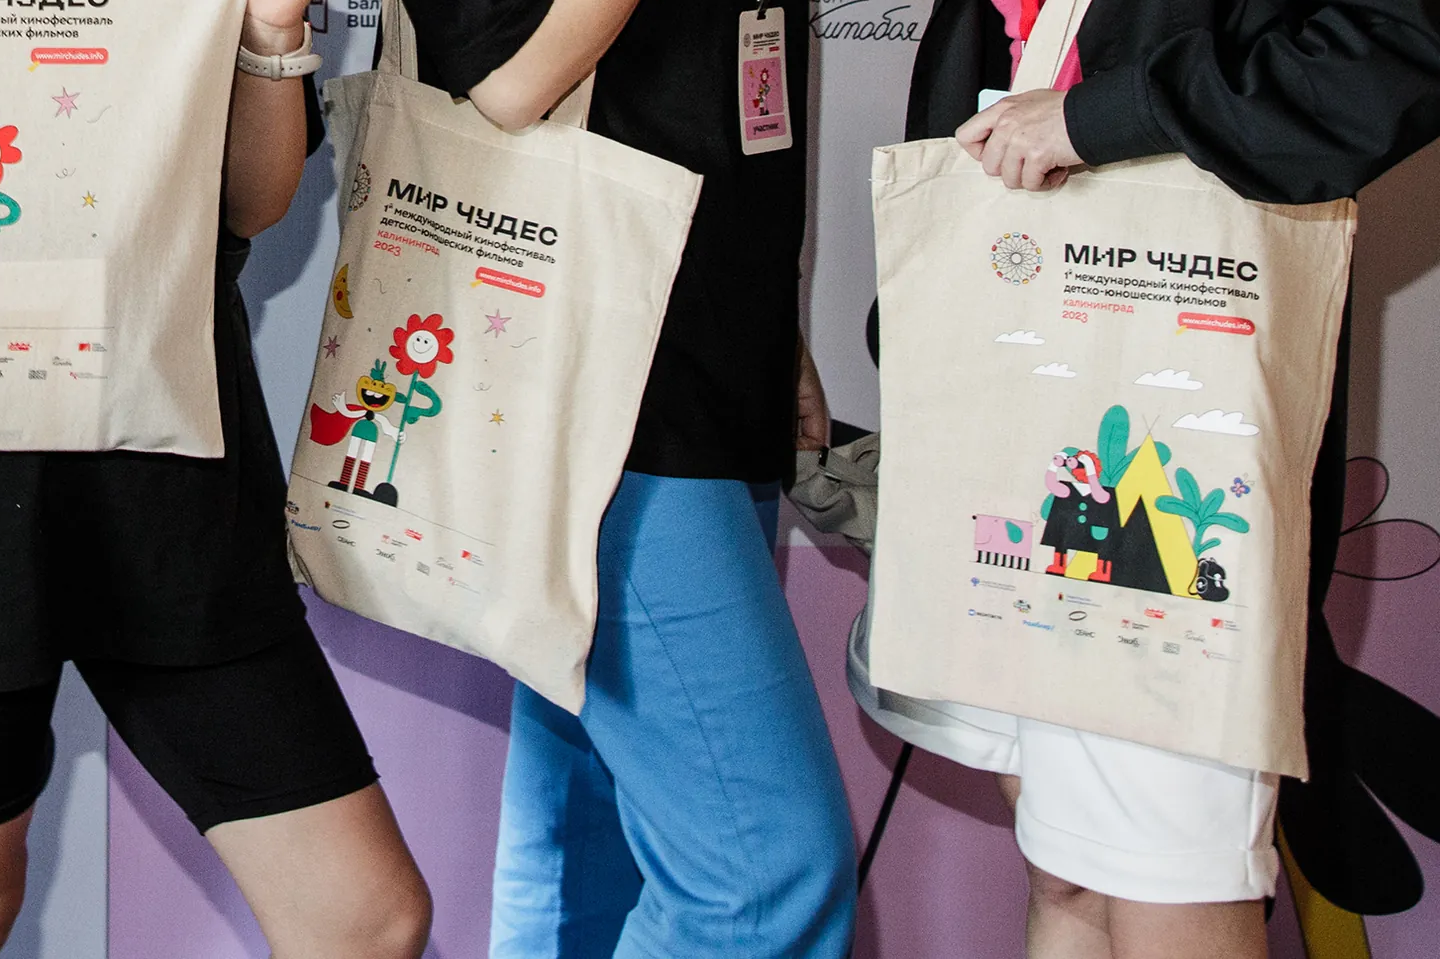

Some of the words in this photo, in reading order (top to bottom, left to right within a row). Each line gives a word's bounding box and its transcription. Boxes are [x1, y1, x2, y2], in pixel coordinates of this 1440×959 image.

[21, 14, 114, 27] кинофестиваль
[26, 27, 80, 39] фильмов
[347, 14, 376, 28] ВШ
[387, 178, 448, 212] МИР
[456, 201, 558, 246] ЧУДЕС
[377, 229, 440, 256] калининград
[380, 217, 474, 254] детско-юношеских
[476, 247, 524, 268] фильмов
[394, 207, 472, 241] международный
[474, 234, 556, 265] кинофестиваль
[373, 241, 402, 257] 2023
[1064, 243, 1137, 268] МИР
[1147, 249, 1259, 282] ЧУДЕС
[1063, 283, 1172, 303] детско-юношеских
[1174, 293, 1227, 308] фильмов
[1074, 272, 1168, 289] международный
[1169, 280, 1260, 301] кинофестиваль
[1062, 310, 1089, 324] 2023
[1063, 298, 1134, 314] калининград
